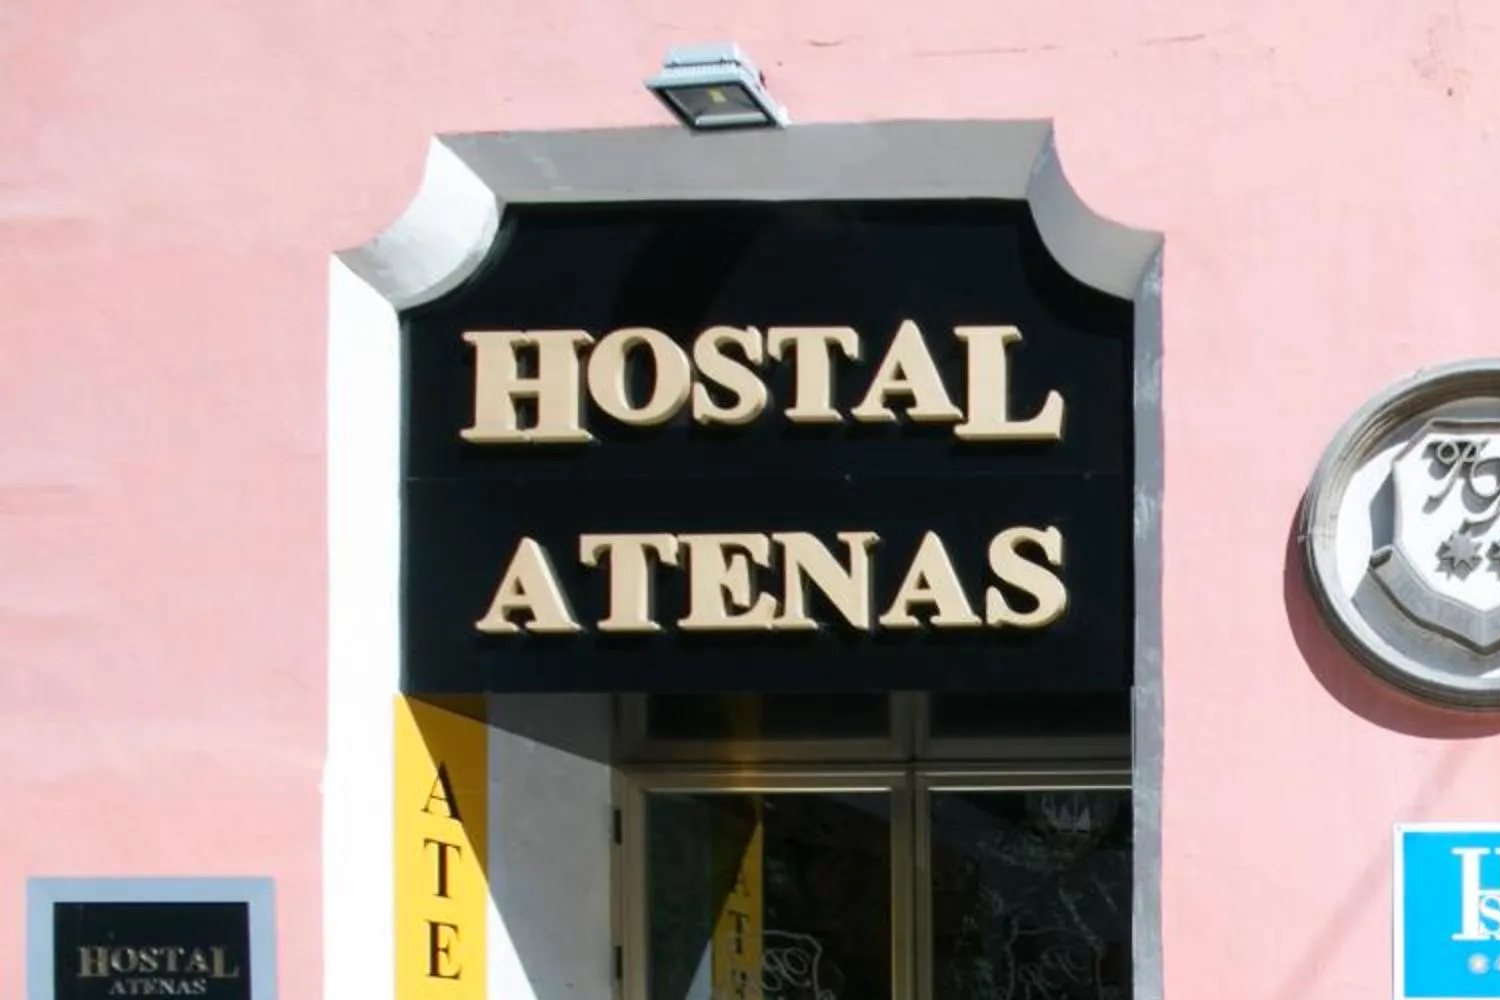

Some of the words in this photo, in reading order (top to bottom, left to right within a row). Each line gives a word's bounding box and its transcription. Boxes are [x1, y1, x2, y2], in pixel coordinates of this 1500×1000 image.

[460, 319, 1066, 443] HOSTAL
[475, 525, 1070, 633] ATENAS
[77, 945, 240, 979] HOSTAL
[108, 978, 208, 996] ATENAS
